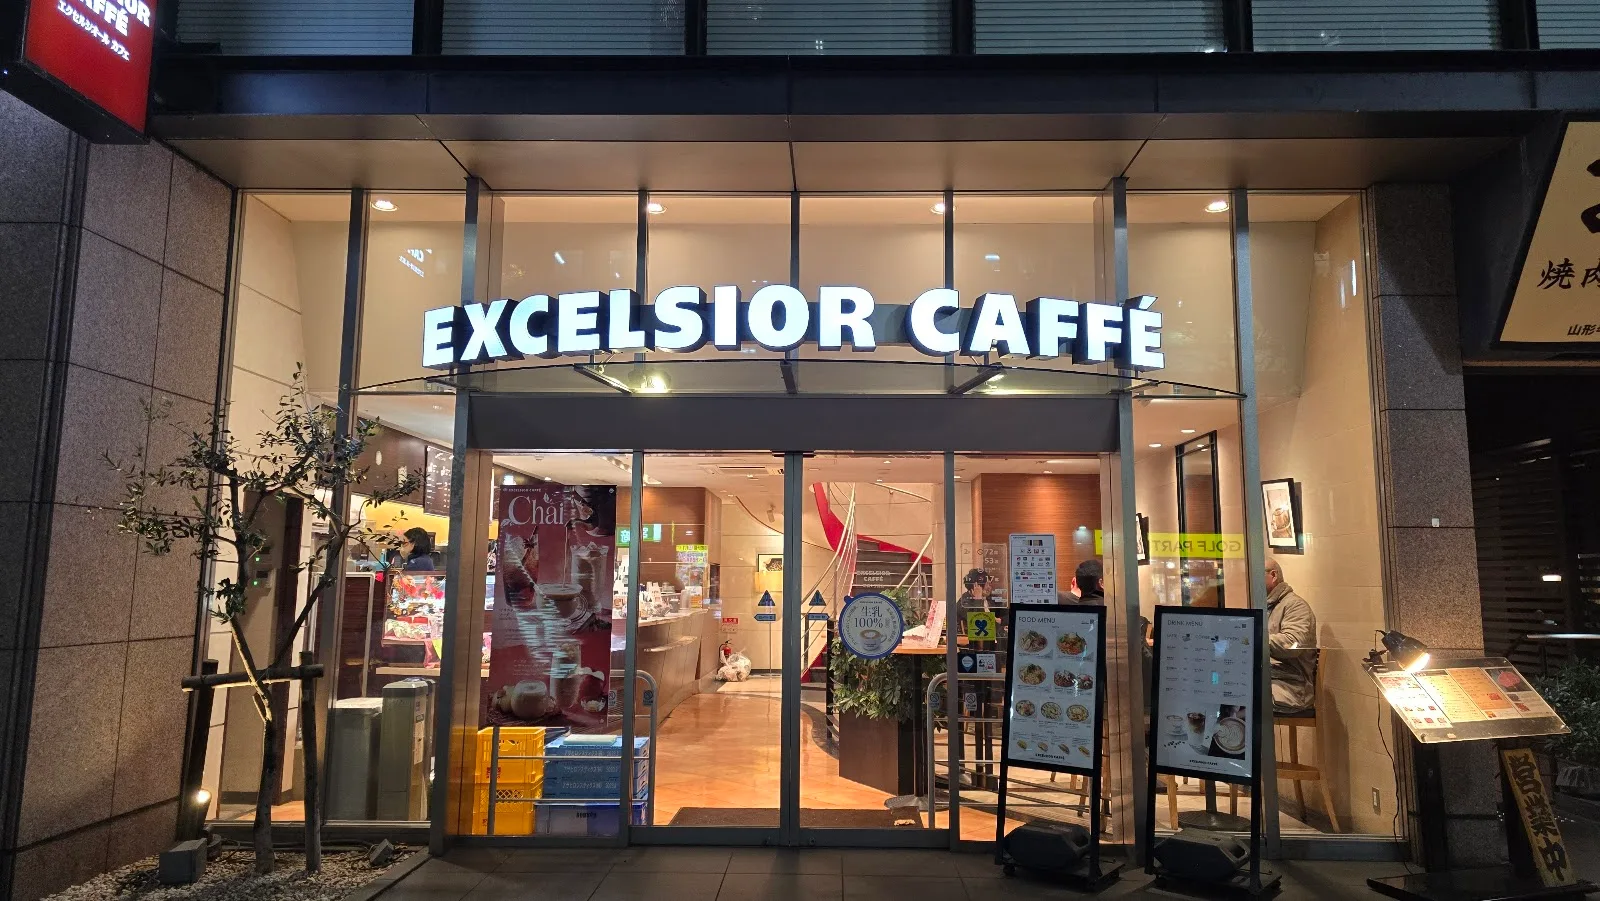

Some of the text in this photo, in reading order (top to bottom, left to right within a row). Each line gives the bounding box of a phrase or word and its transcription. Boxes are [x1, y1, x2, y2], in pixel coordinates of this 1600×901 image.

[422, 284, 1165, 372] EXCELSIOR CAFFÉ
[1567, 323, 1600, 336] 山形
[508, 495, 564, 525] Chai
[861, 605, 883, 618] 生乳
[854, 617, 884, 628] 100%
[1509, 752, 1568, 882] 営業中
